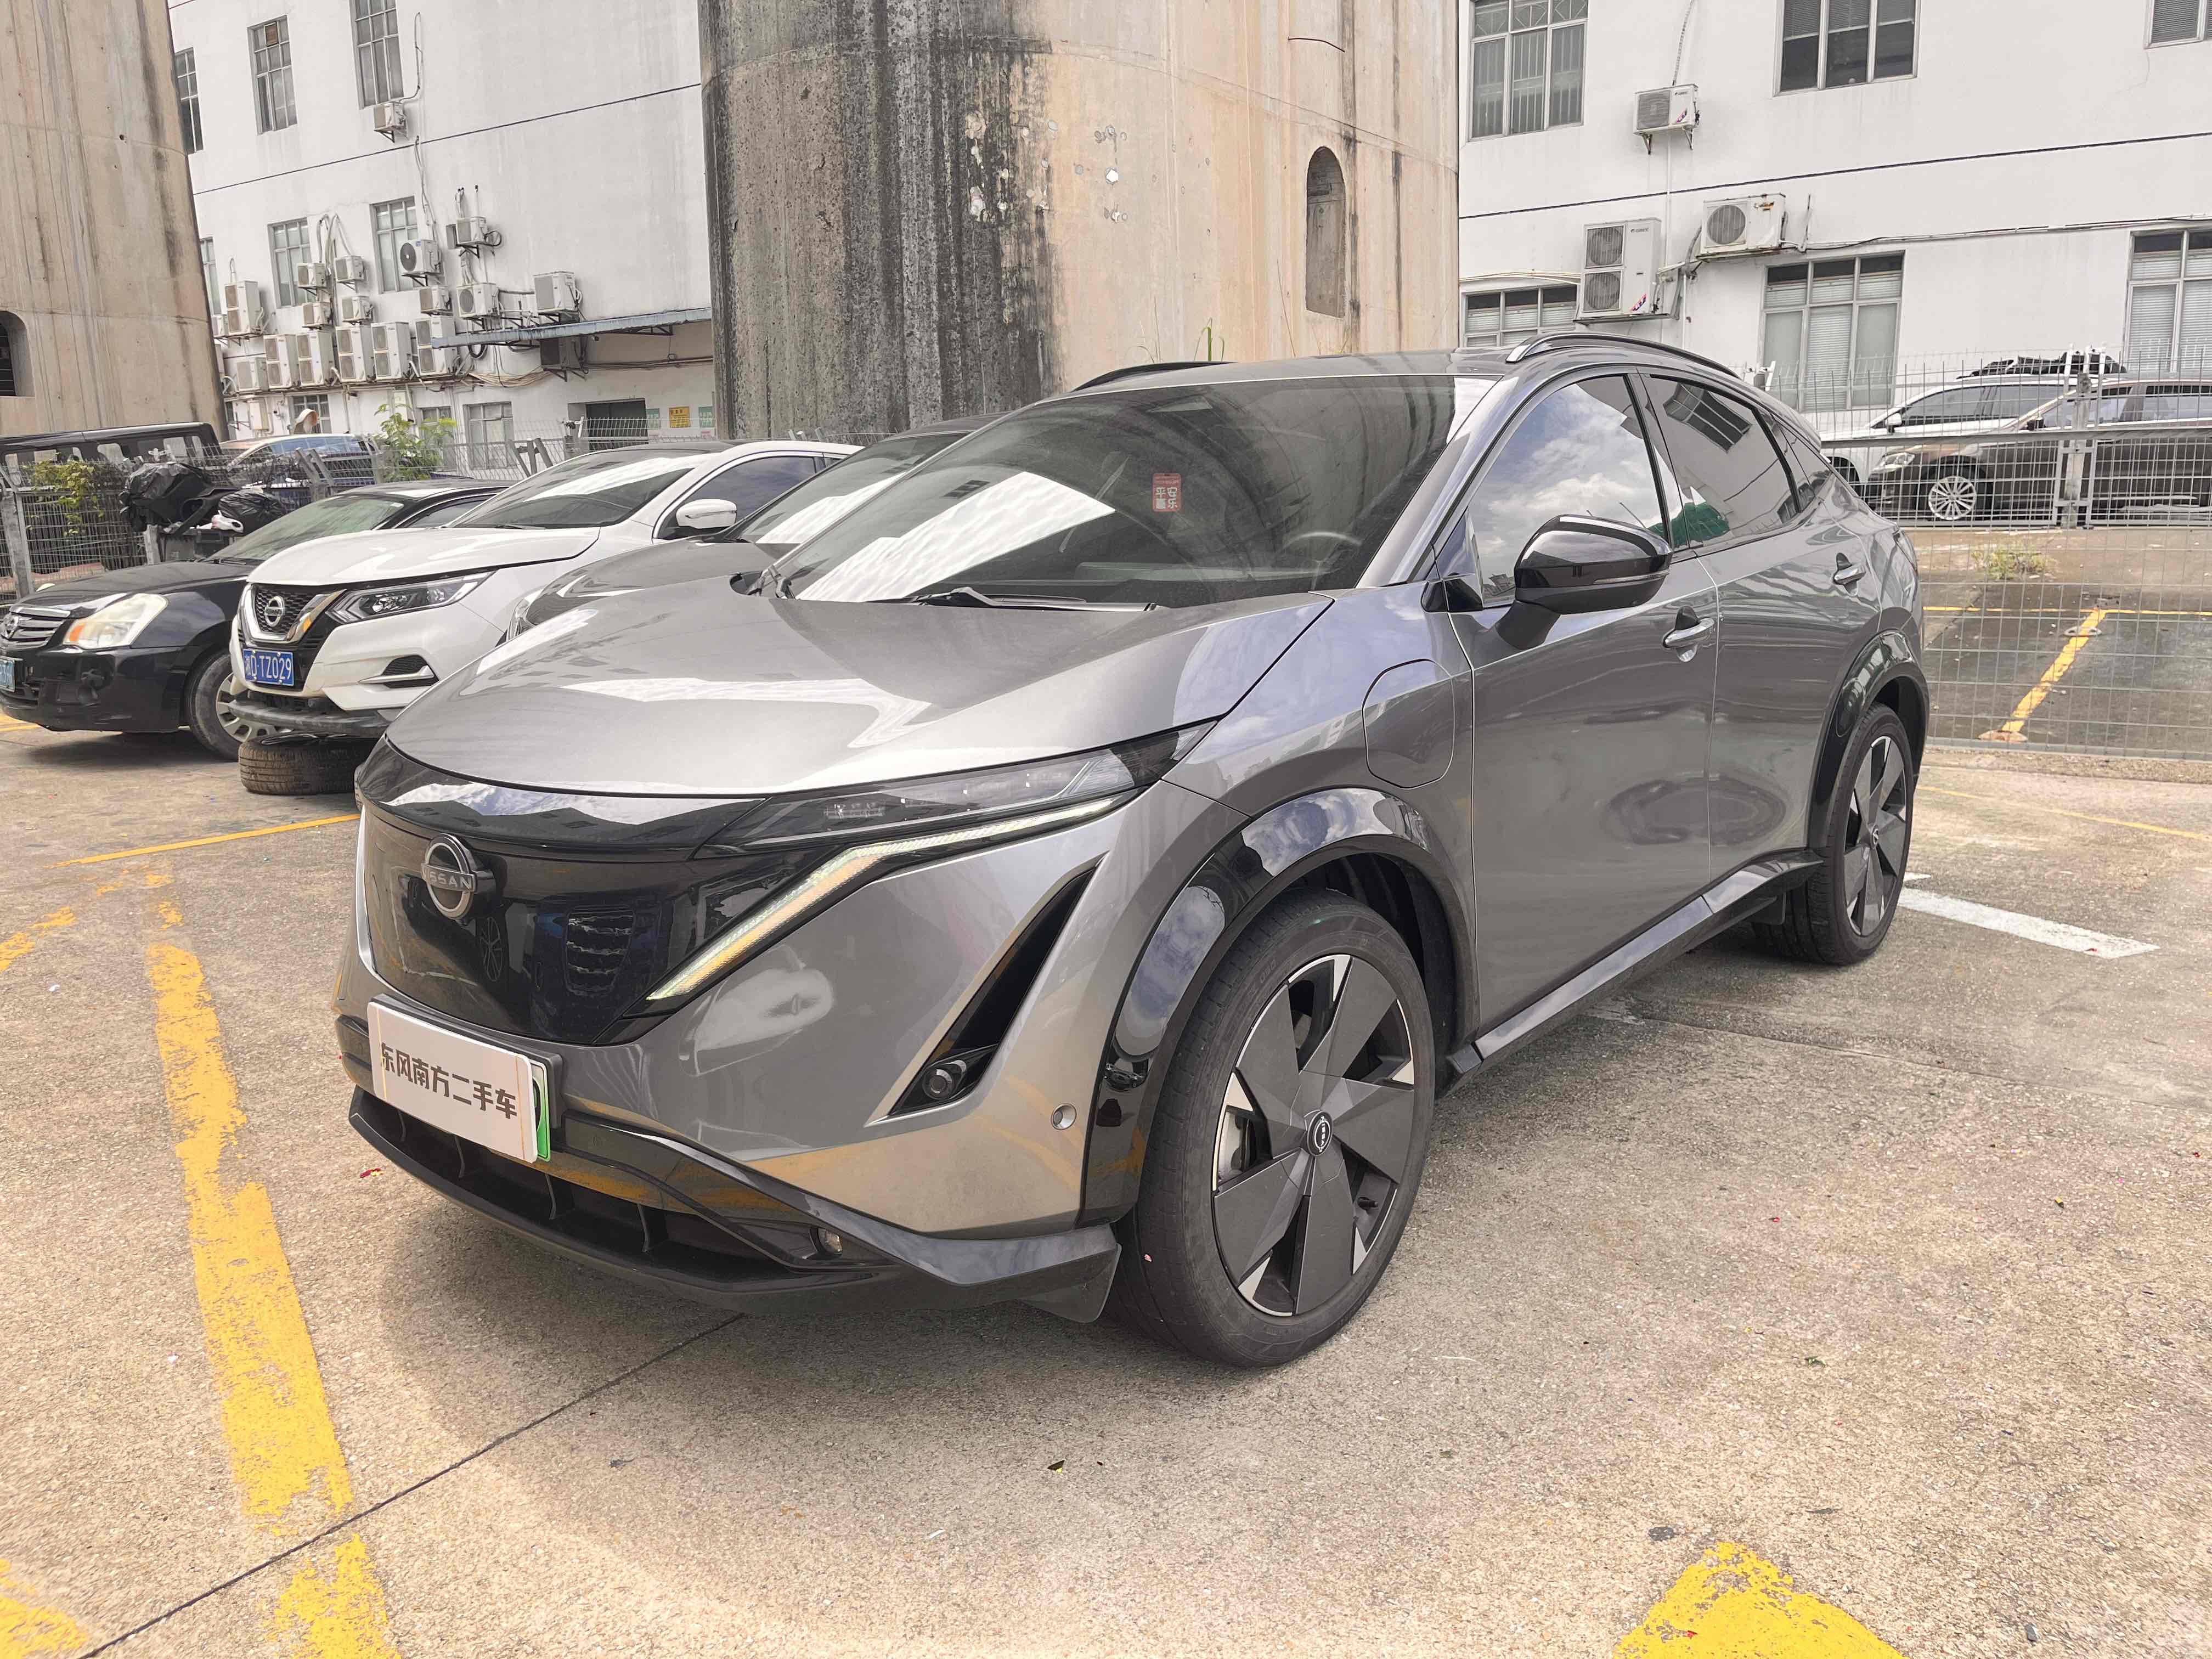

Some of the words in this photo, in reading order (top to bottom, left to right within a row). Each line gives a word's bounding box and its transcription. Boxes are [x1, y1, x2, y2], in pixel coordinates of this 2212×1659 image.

[381, 1042, 517, 1120] 东风南方二手车
